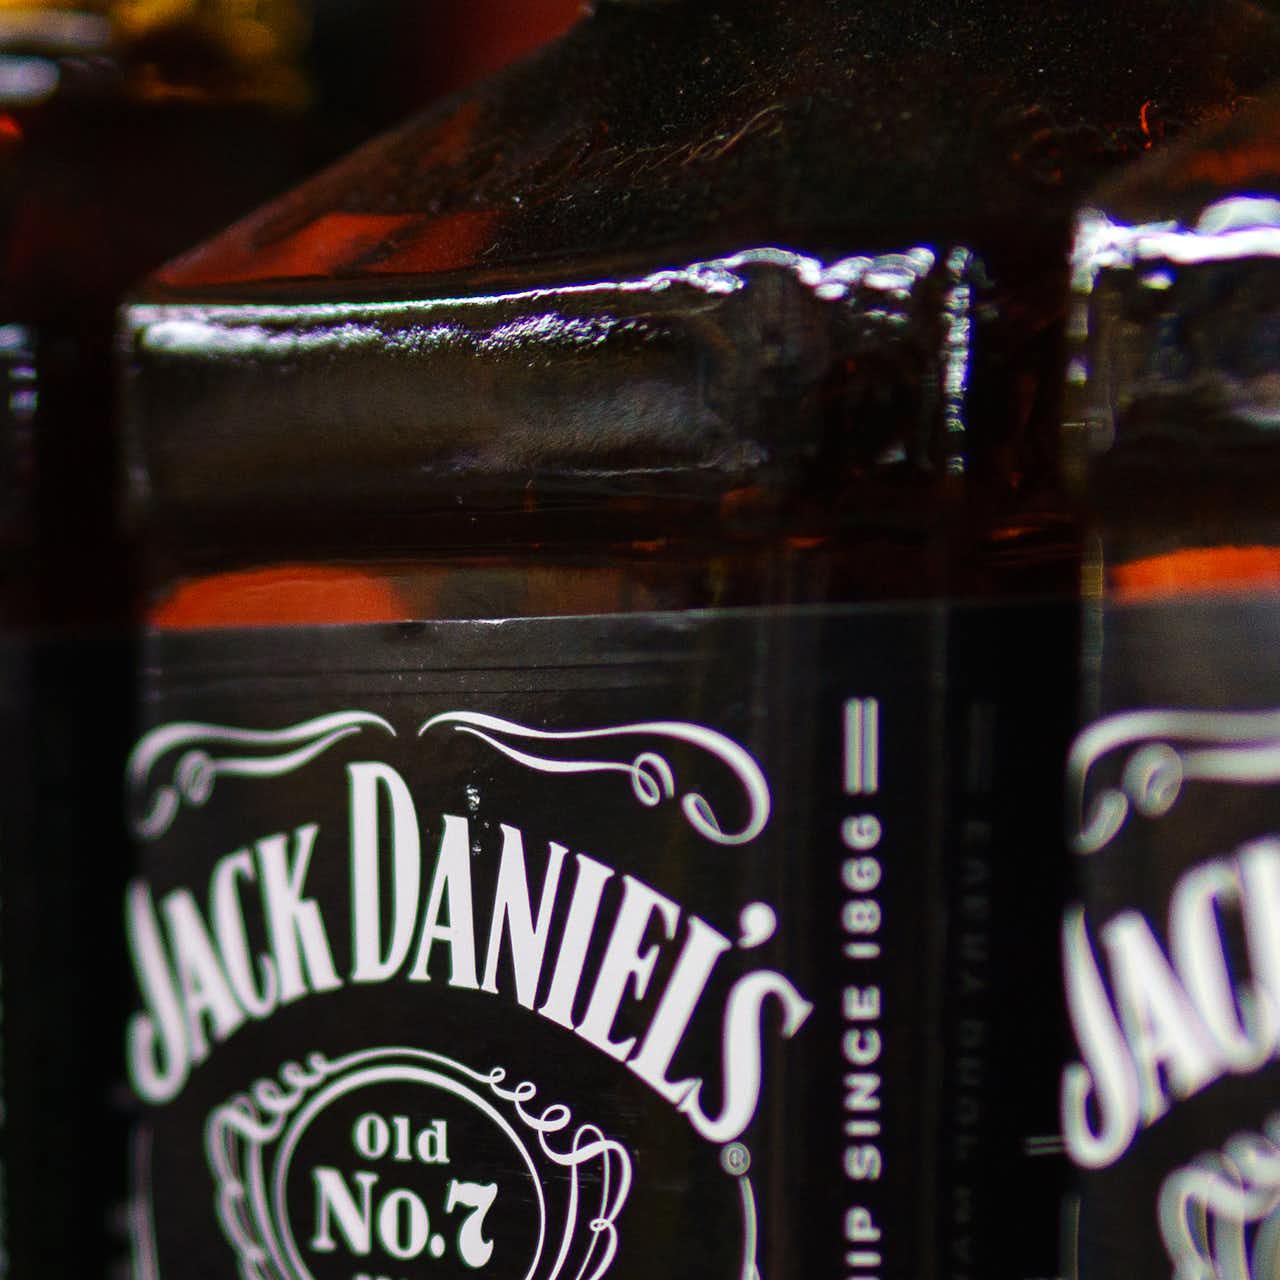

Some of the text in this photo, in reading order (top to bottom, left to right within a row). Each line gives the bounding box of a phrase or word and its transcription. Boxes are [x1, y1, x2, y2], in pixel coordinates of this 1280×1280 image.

[128, 762, 813, 1142] JACK DANIEL'S
[841, 813, 882, 958] 1866
[844, 986, 882, 1180] SINCE
[1062, 834, 1280, 1168] JAC
[311, 1169, 499, 1268] No.7
[354, 1113, 450, 1165] Old
